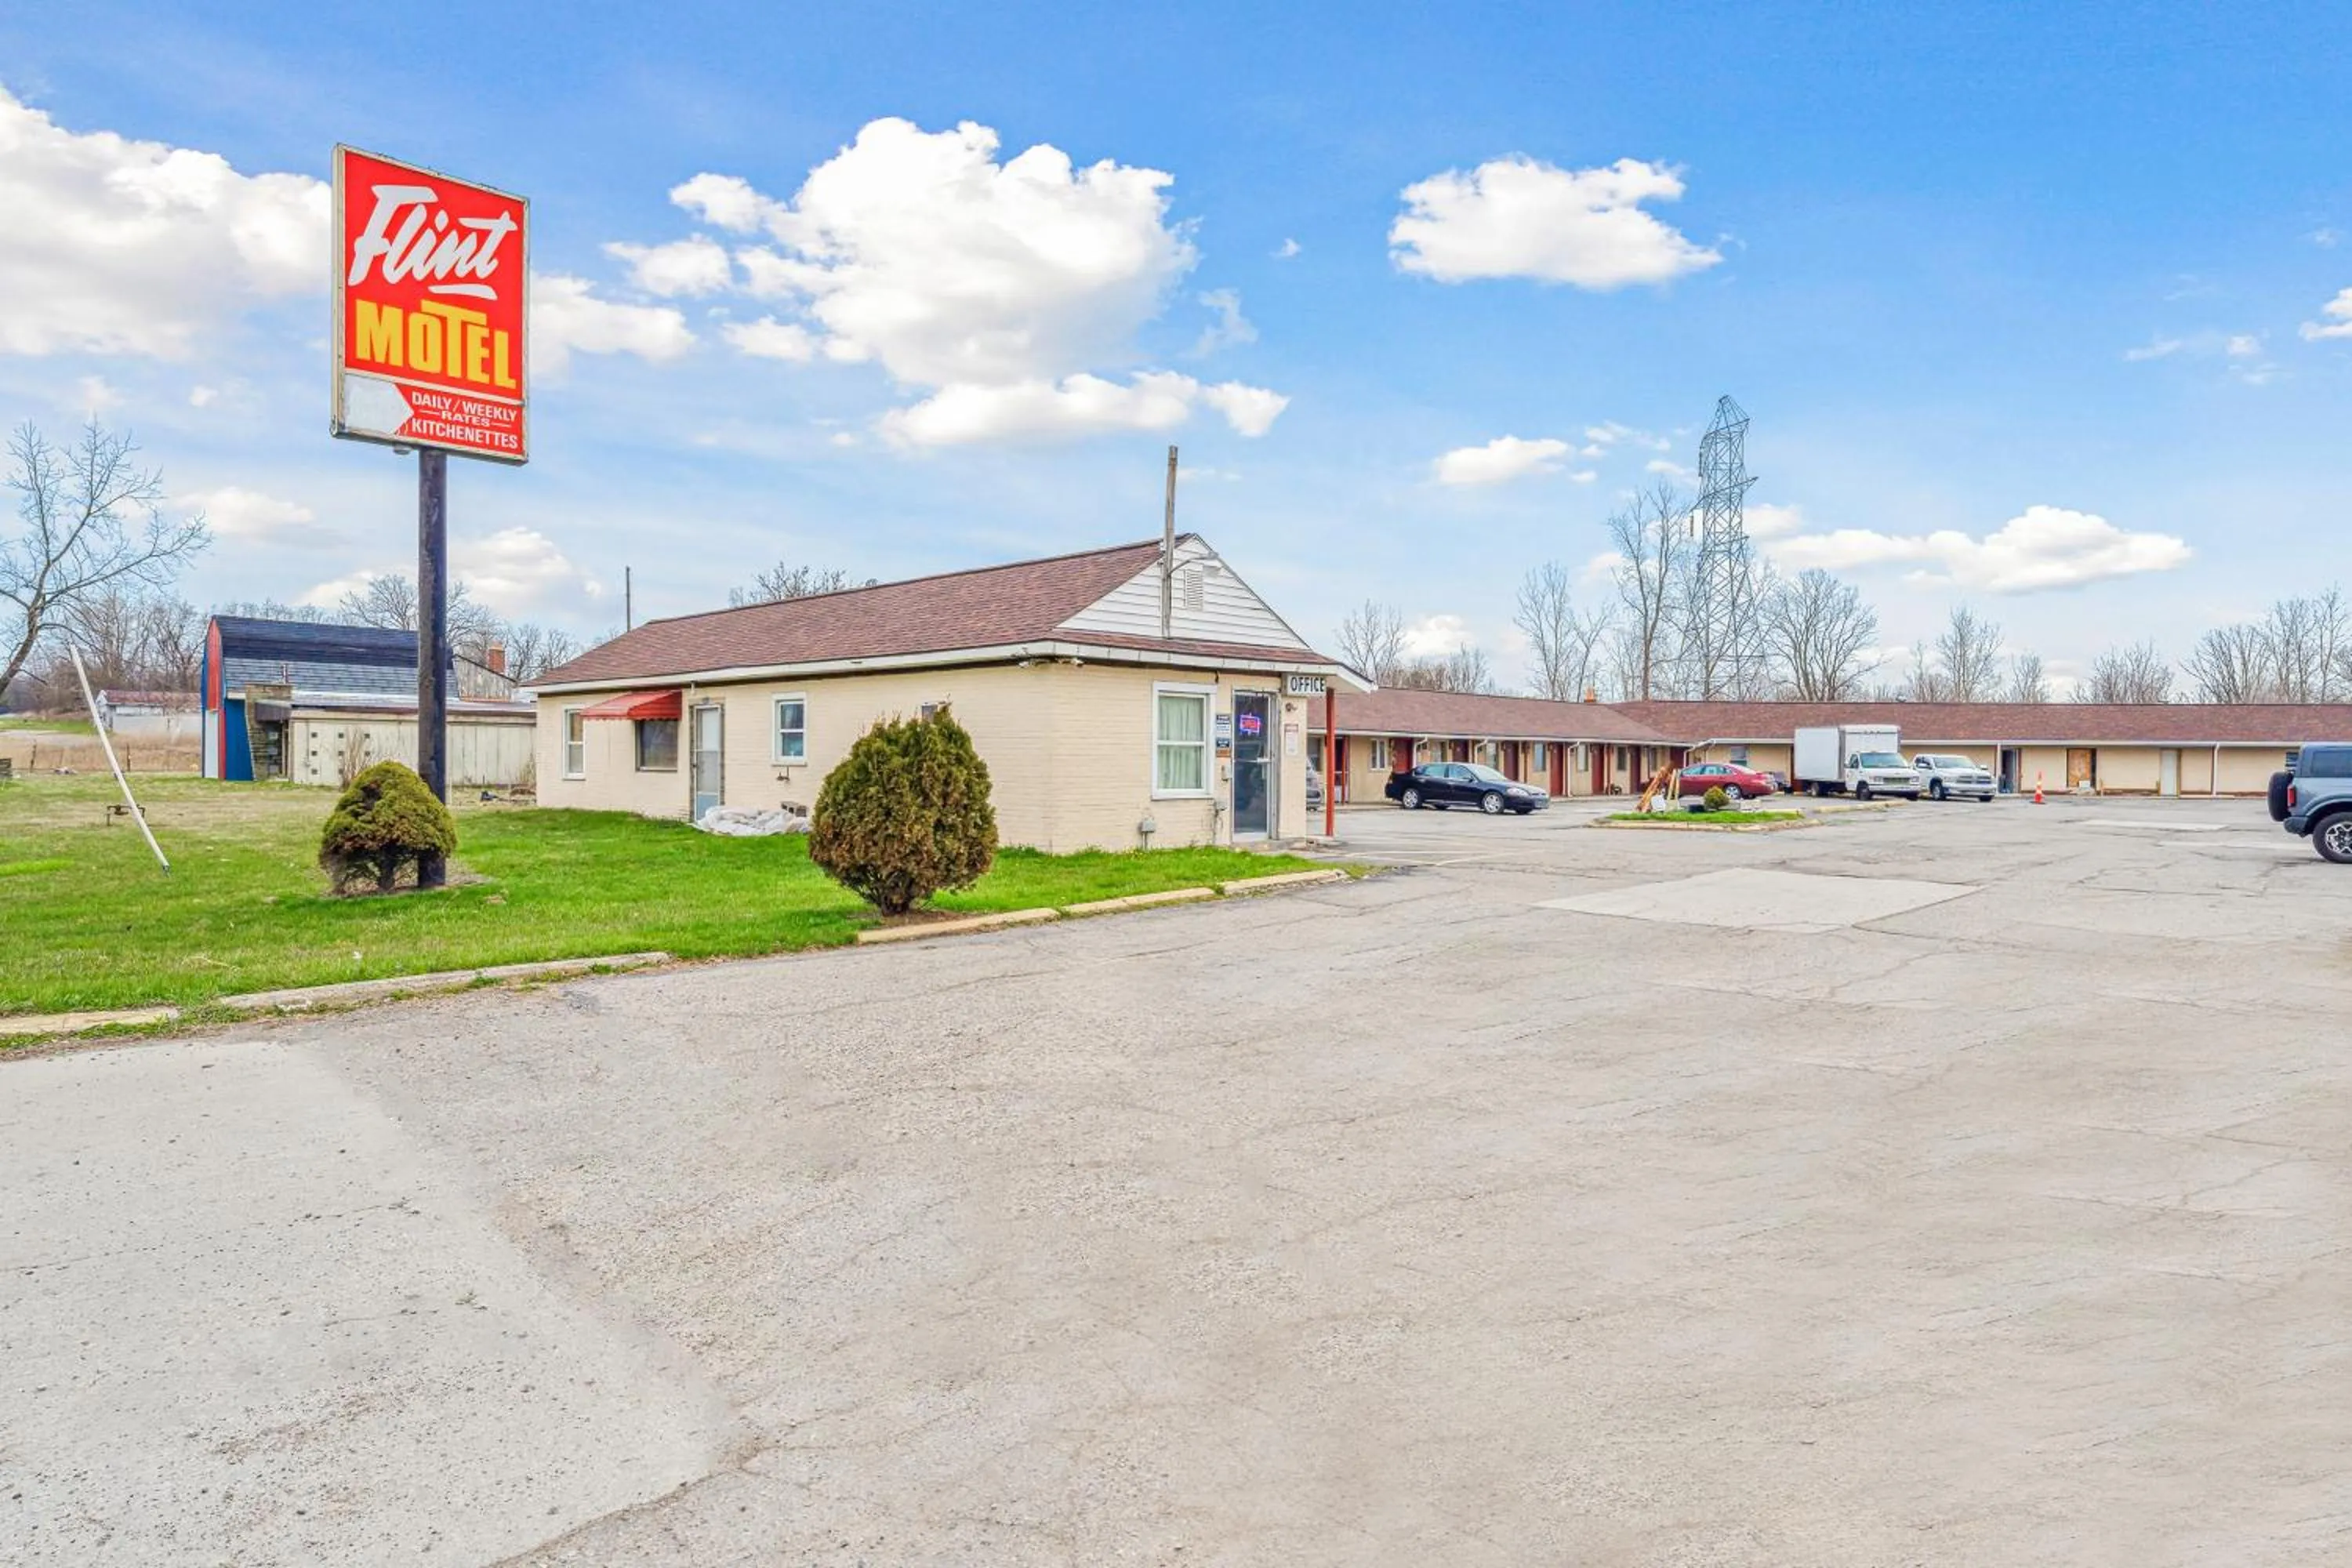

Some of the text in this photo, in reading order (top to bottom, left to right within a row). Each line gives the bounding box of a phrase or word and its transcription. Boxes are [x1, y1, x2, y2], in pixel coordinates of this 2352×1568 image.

[348, 184, 518, 287] Flint
[355, 299, 517, 390] MOTEL
[412, 418, 518, 449] KITCHENETTES
[441, 410, 491, 427] RATES
[1290, 677, 1324, 692] OFFICE
